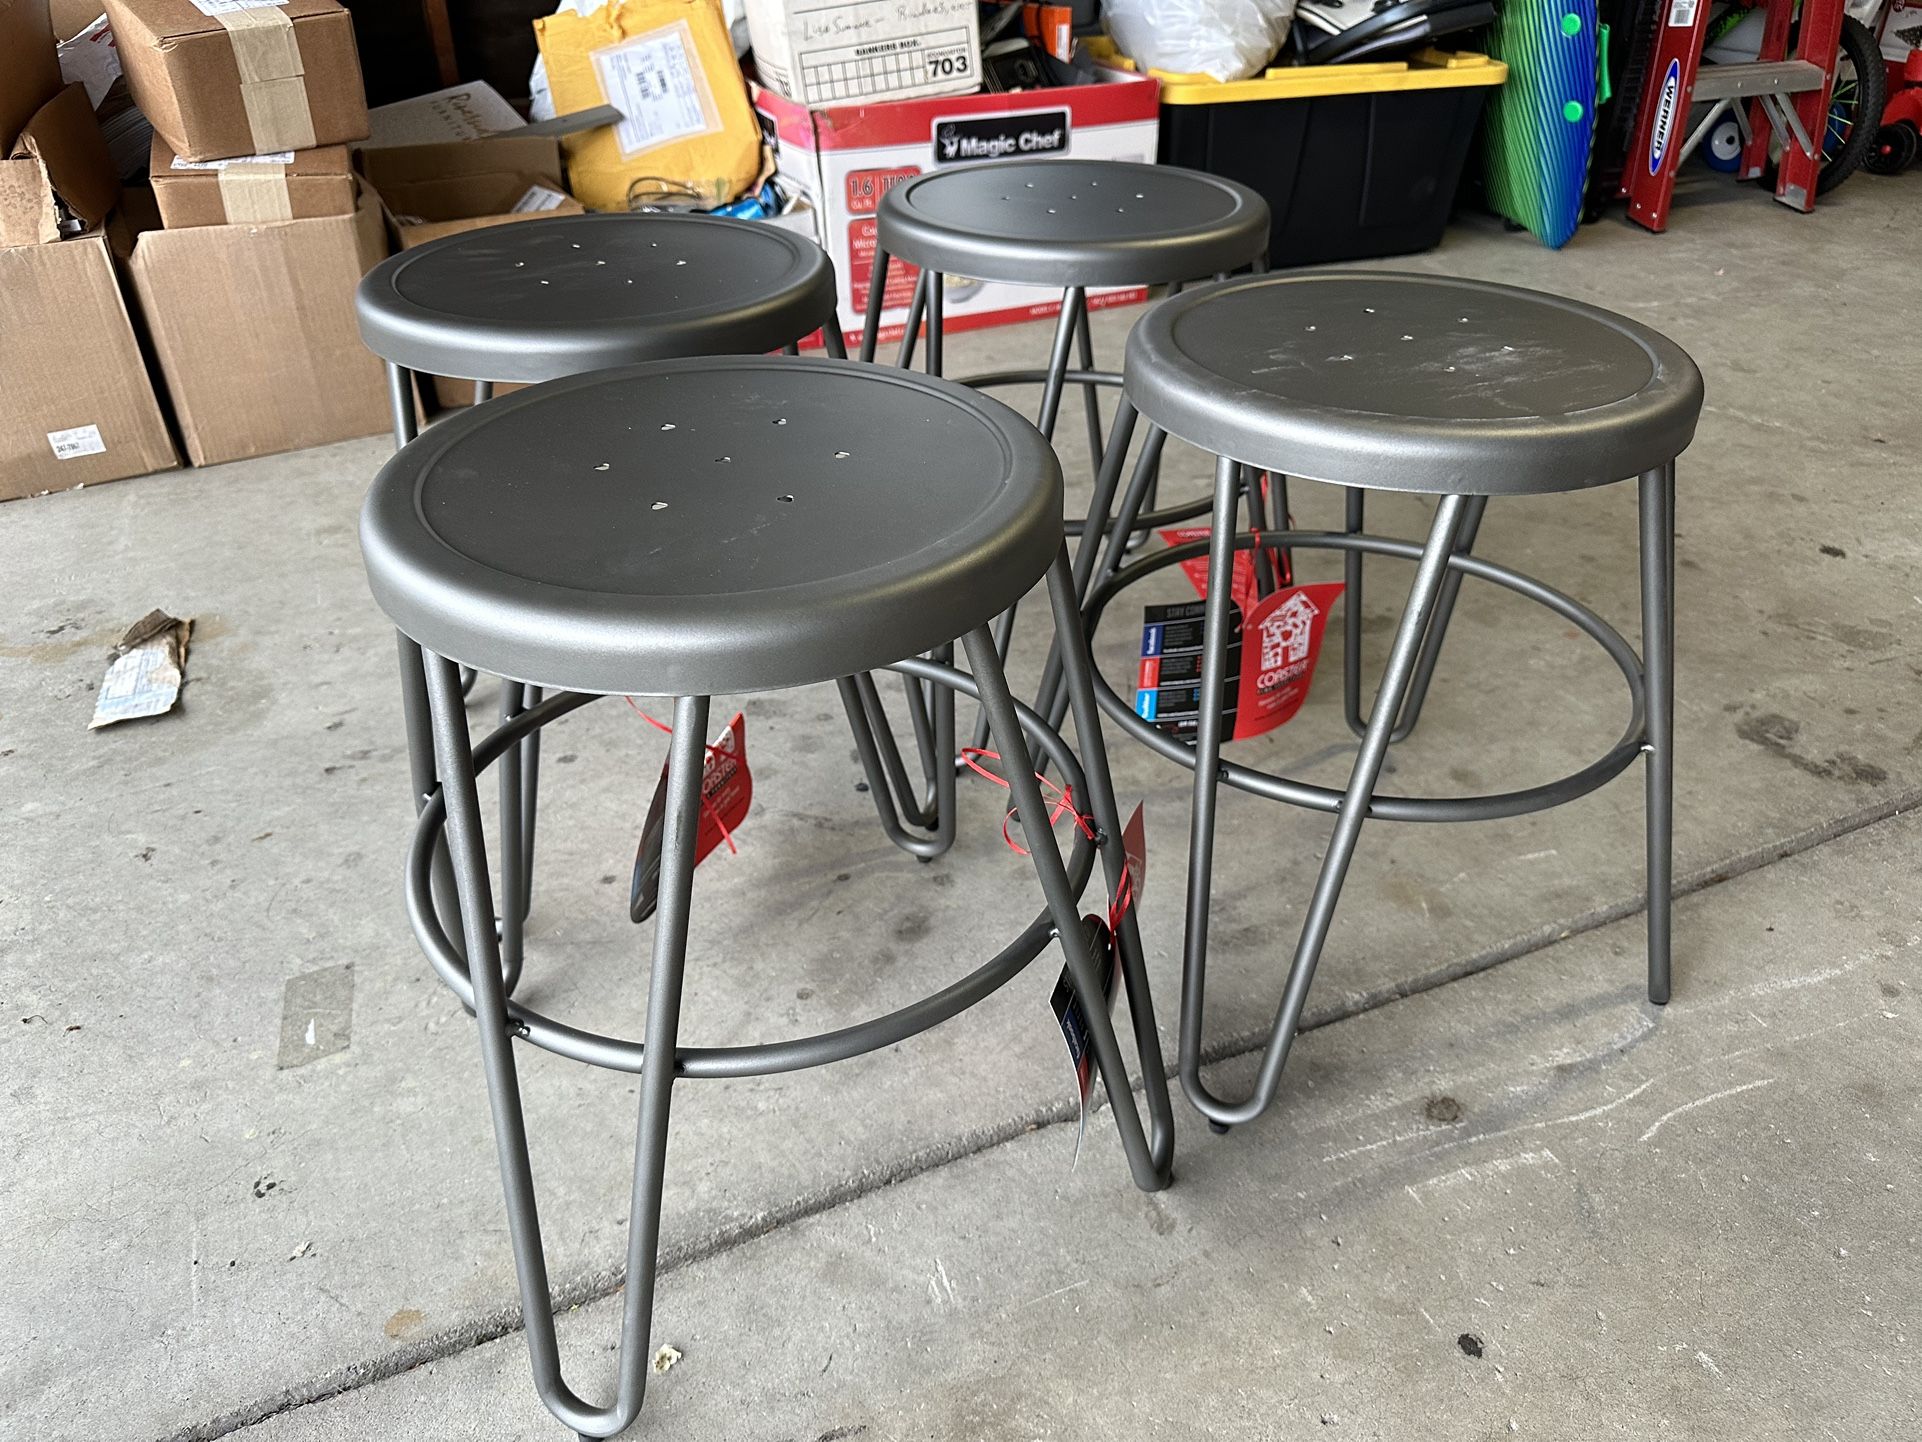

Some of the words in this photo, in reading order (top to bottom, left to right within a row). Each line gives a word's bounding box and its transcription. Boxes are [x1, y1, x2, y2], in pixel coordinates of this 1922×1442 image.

[929, 55, 968, 78] 703
[1655, 85, 1675, 151] WERNER
[961, 134, 1016, 158] Magic
[1018, 128, 1063, 151] Chef
[851, 175, 874, 198] 1.6
